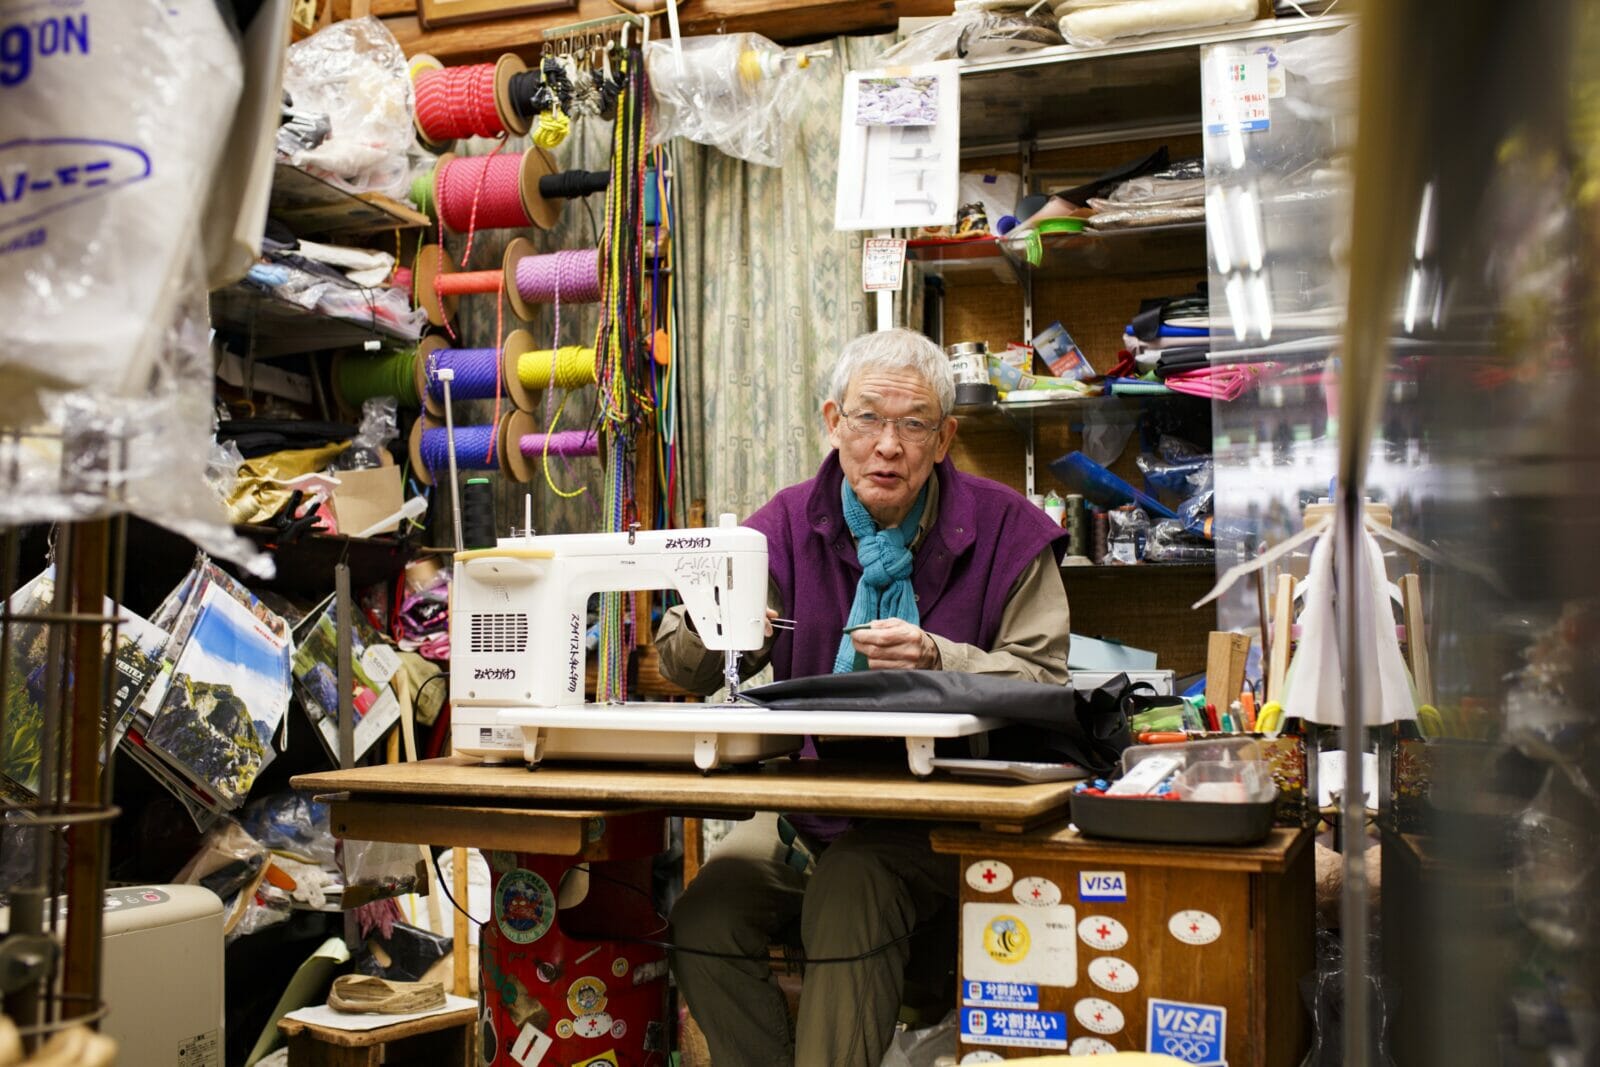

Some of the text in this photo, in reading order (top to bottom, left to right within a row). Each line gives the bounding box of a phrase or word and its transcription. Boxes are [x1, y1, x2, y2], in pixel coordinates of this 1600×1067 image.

[665, 537, 711, 549] みやがわ
[115, 658, 145, 680] VERTEX
[474, 668, 516, 680] みやがわ
[1084, 876, 1123, 890] VISA
[986, 983, 1033, 997] 分割払い
[992, 1011, 1058, 1031] 分割払い
[1154, 1006, 1217, 1037] VISA
